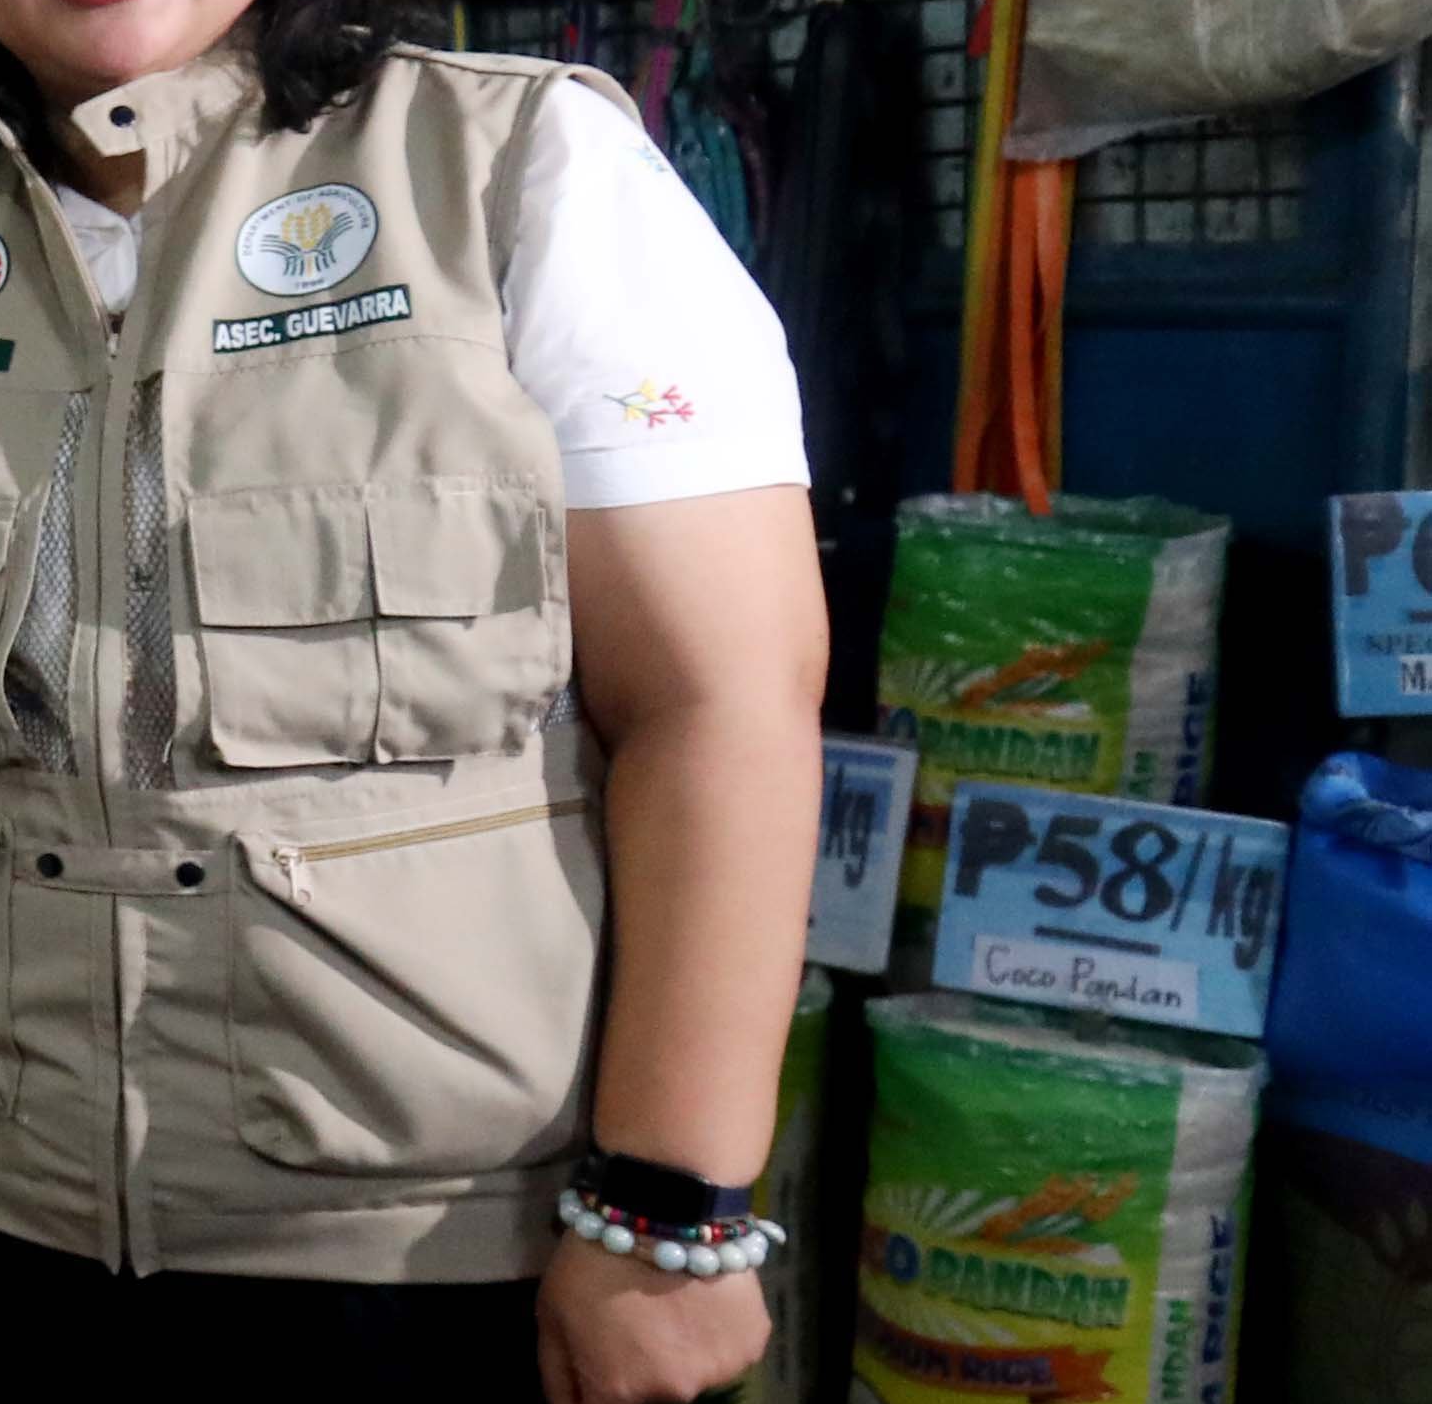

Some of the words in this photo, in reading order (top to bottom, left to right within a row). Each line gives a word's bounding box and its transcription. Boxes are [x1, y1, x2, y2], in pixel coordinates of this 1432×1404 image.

[214, 319, 282, 351] ASEC.
[286, 289, 410, 336] GUEVARRA
[985, 943, 1056, 988] Coco
[1070, 955, 1182, 1009] Pandan
[925, 1246, 1132, 1328] PANDAN
